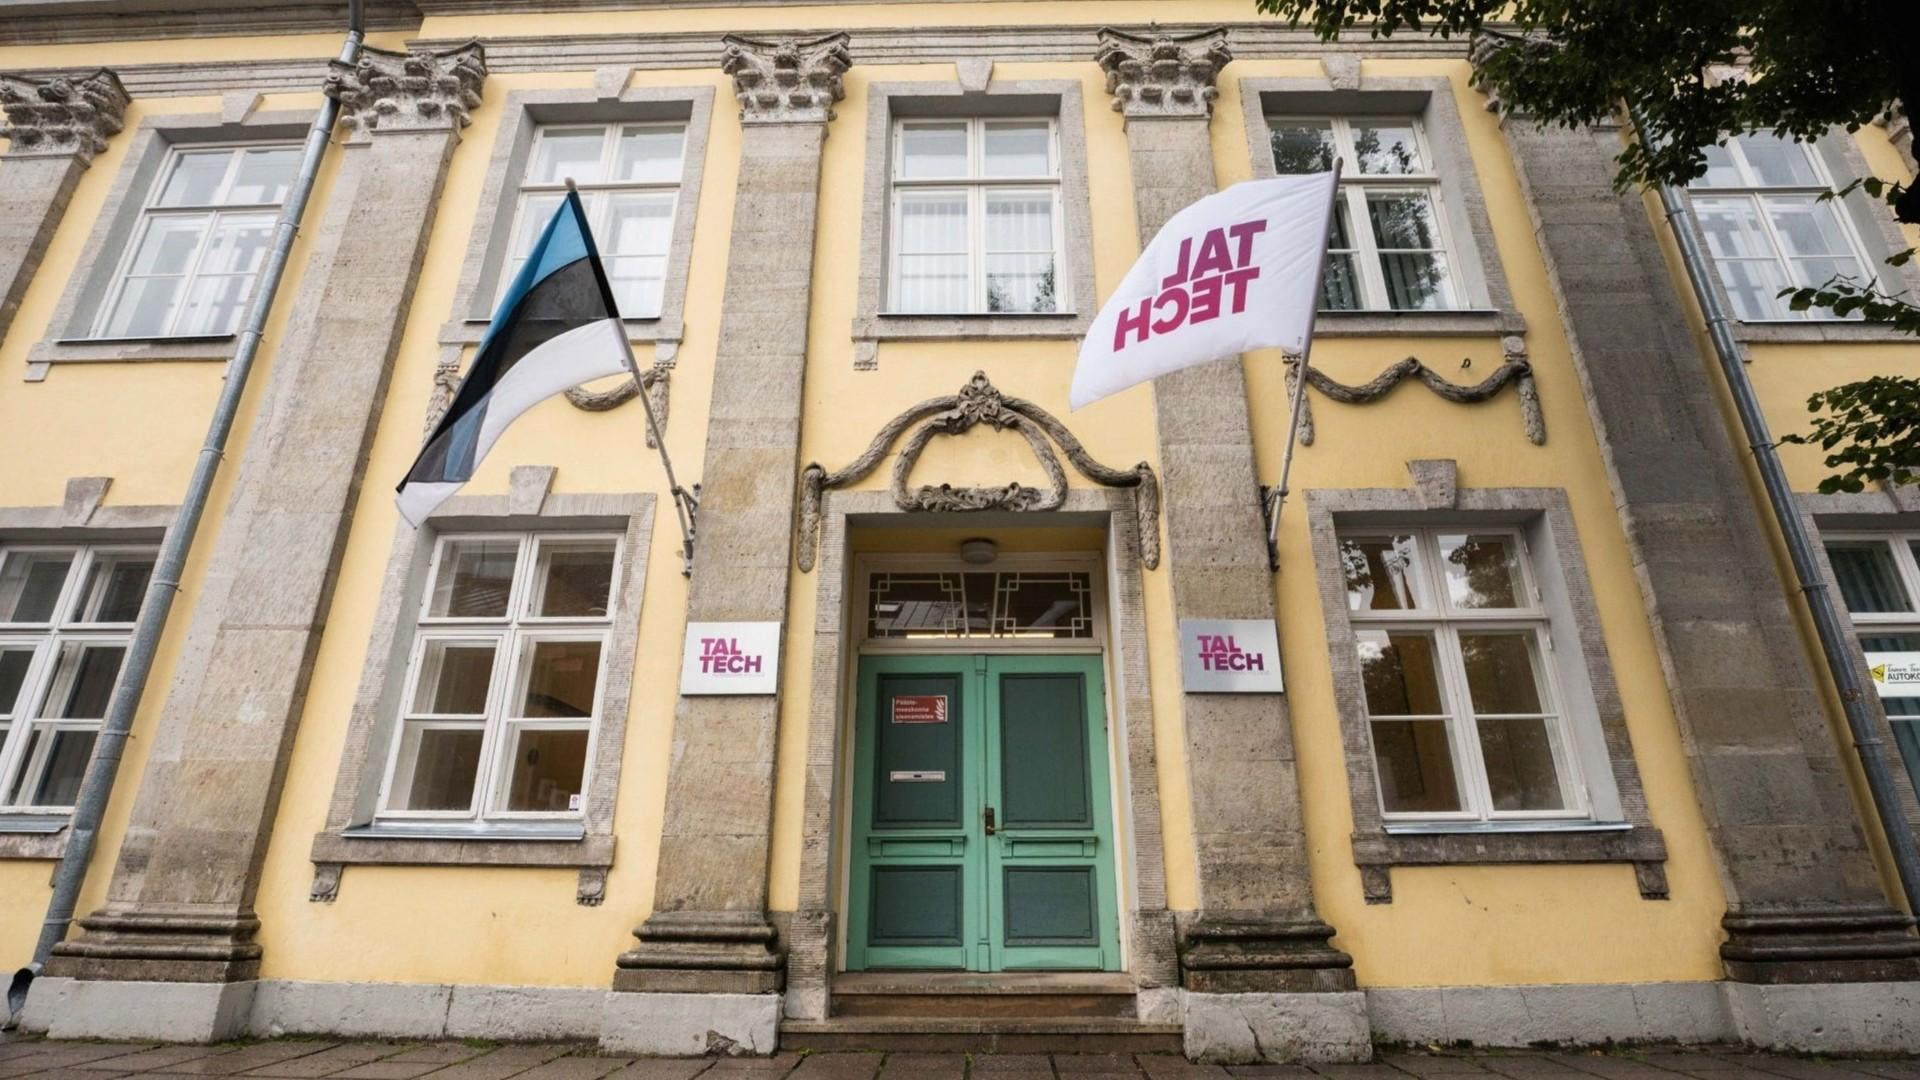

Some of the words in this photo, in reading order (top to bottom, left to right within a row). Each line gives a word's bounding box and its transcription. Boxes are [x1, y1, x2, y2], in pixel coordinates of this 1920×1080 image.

[701, 638, 742, 655] TAL
[1197, 635, 1241, 652] TAL
[699, 655, 762, 673] TECH
[1199, 653, 1264, 671] TECH
